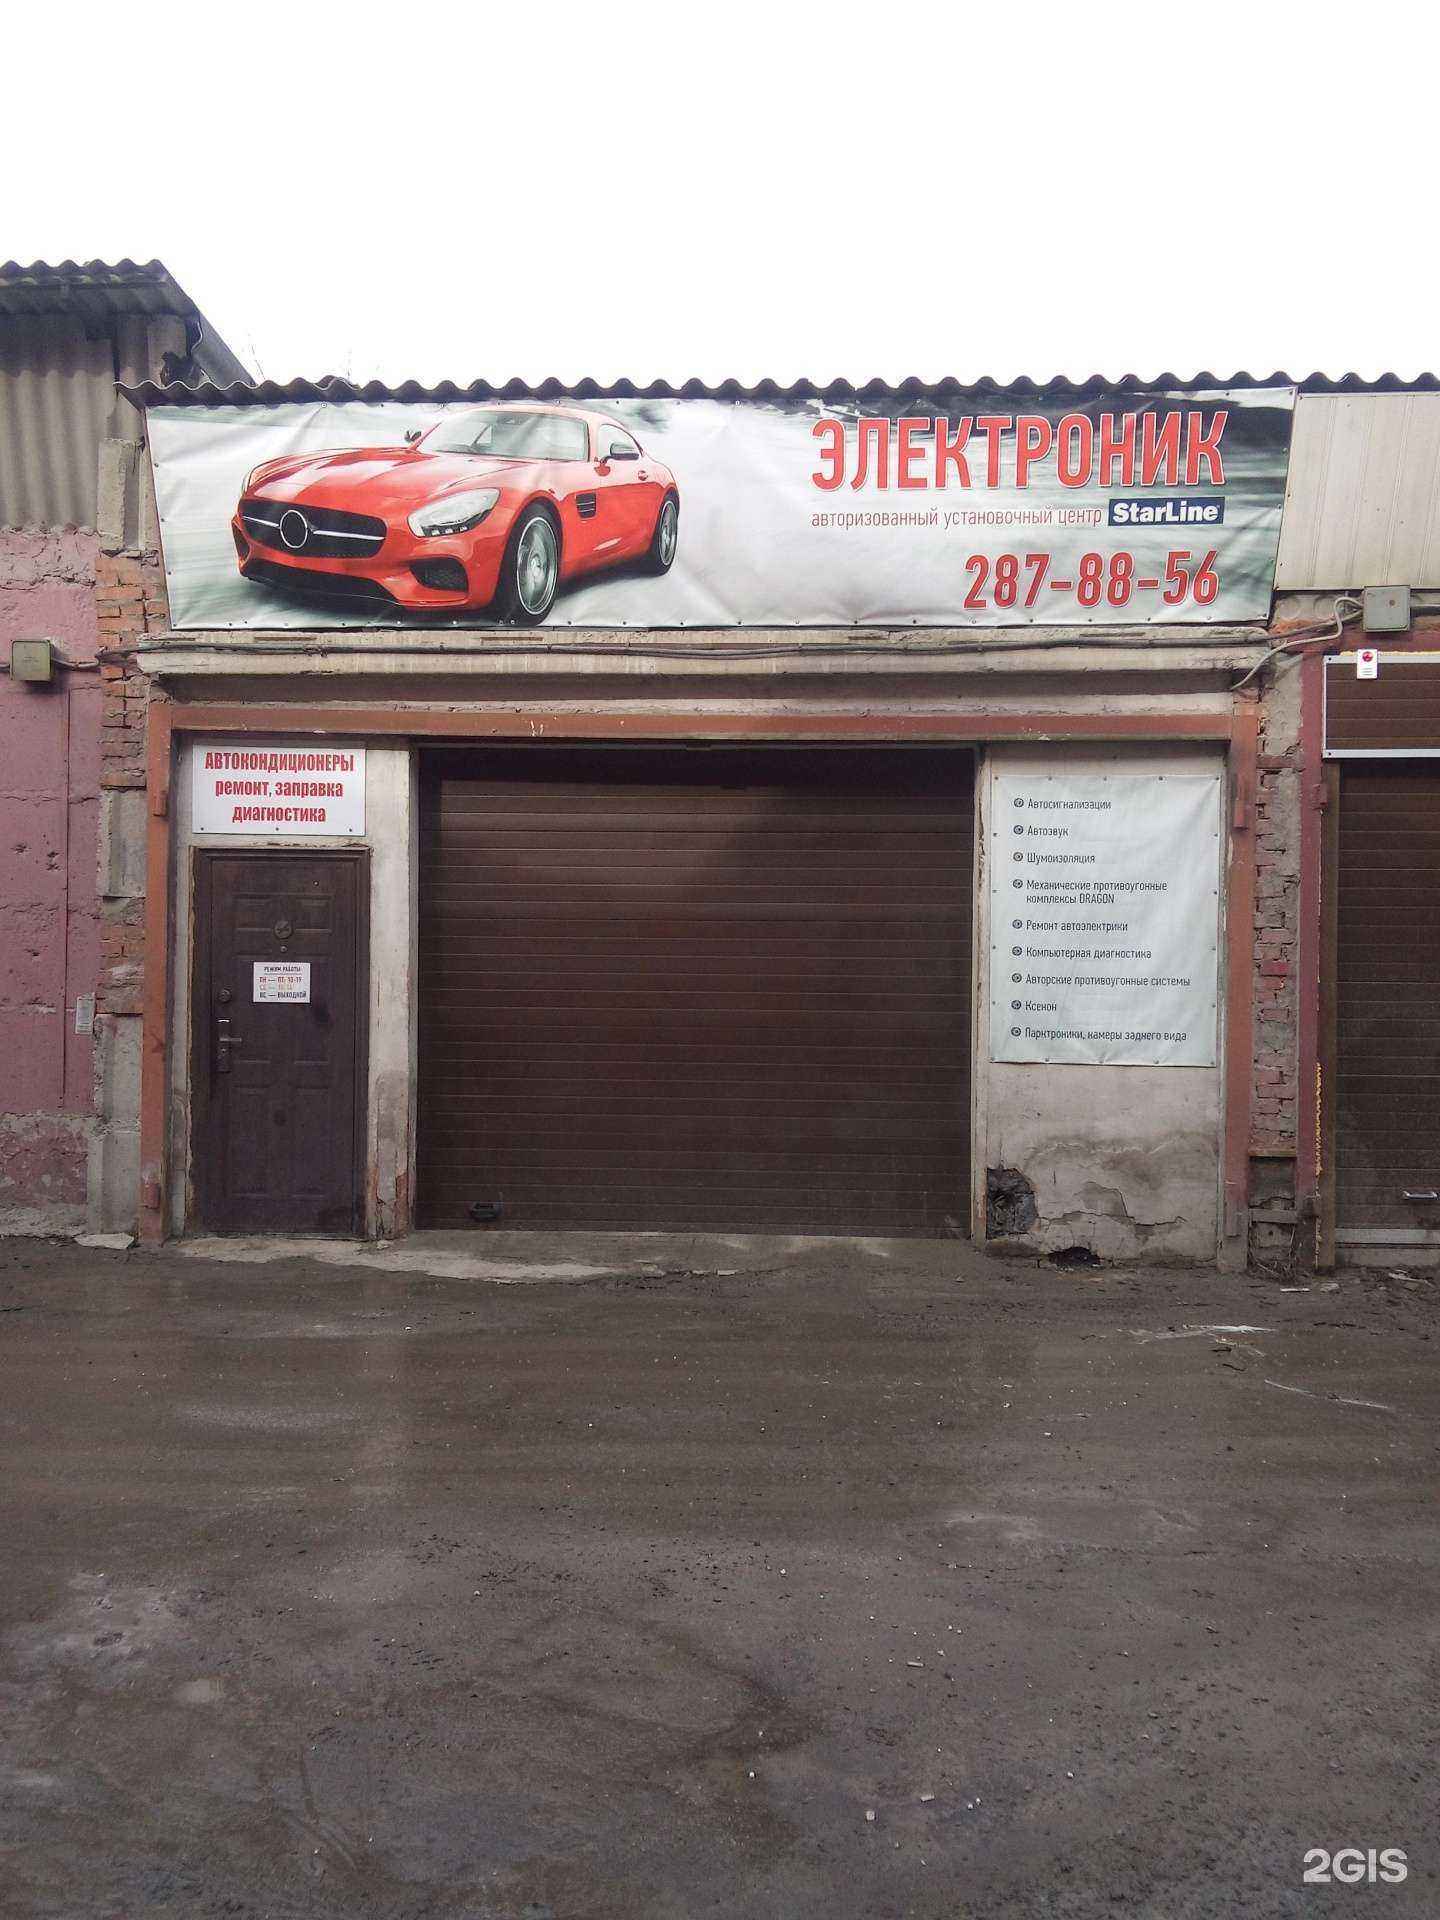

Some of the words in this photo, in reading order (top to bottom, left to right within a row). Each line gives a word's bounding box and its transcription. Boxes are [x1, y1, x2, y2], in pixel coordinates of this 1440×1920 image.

[810, 410, 1229, 492] ЭЛЕКТРОНИК
[811, 506, 938, 531] авторизованный
[943, 504, 1052, 530] установочный
[1058, 507, 1102, 526] центр
[1112, 501, 1219, 523] StarLine
[963, 550, 1219, 610] 287-88-56
[205, 752, 354, 773] АВТОКОНДИЦИОНЕРЫ
[215, 780, 272, 798] ремонт,
[275, 782, 343, 799] заправка
[1027, 798, 1112, 811] Автосигнализации
[232, 806, 326, 823] диагностика
[1027, 825, 1069, 838] Автозвук
[1027, 852, 1096, 866] Шумоизоляция
[1026, 879, 1091, 891] Механические
[1094, 881, 1168, 894] противоугонные
[1026, 895, 1077, 904] комплексы
[1079, 893, 1115, 904] DRAGON
[1026, 919, 1058, 931] Ремонт
[1060, 921, 1128, 933] автоэлектрики
[1026, 947, 1091, 960] Компьютерная
[1094, 949, 1152, 961] диагностика
[1025, 974, 1072, 985] Авторские
[1074, 975, 1149, 988] противоугонные
[1151, 977, 1190, 986] системы
[1025, 1000, 1057, 1011] Ксенон
[1025, 1027, 1085, 1040] Парктроники,
[1087, 1030, 1122, 1041] камеры
[1124, 1031, 1161, 1041] заднего
[1164, 1031, 1187, 1041] вида
